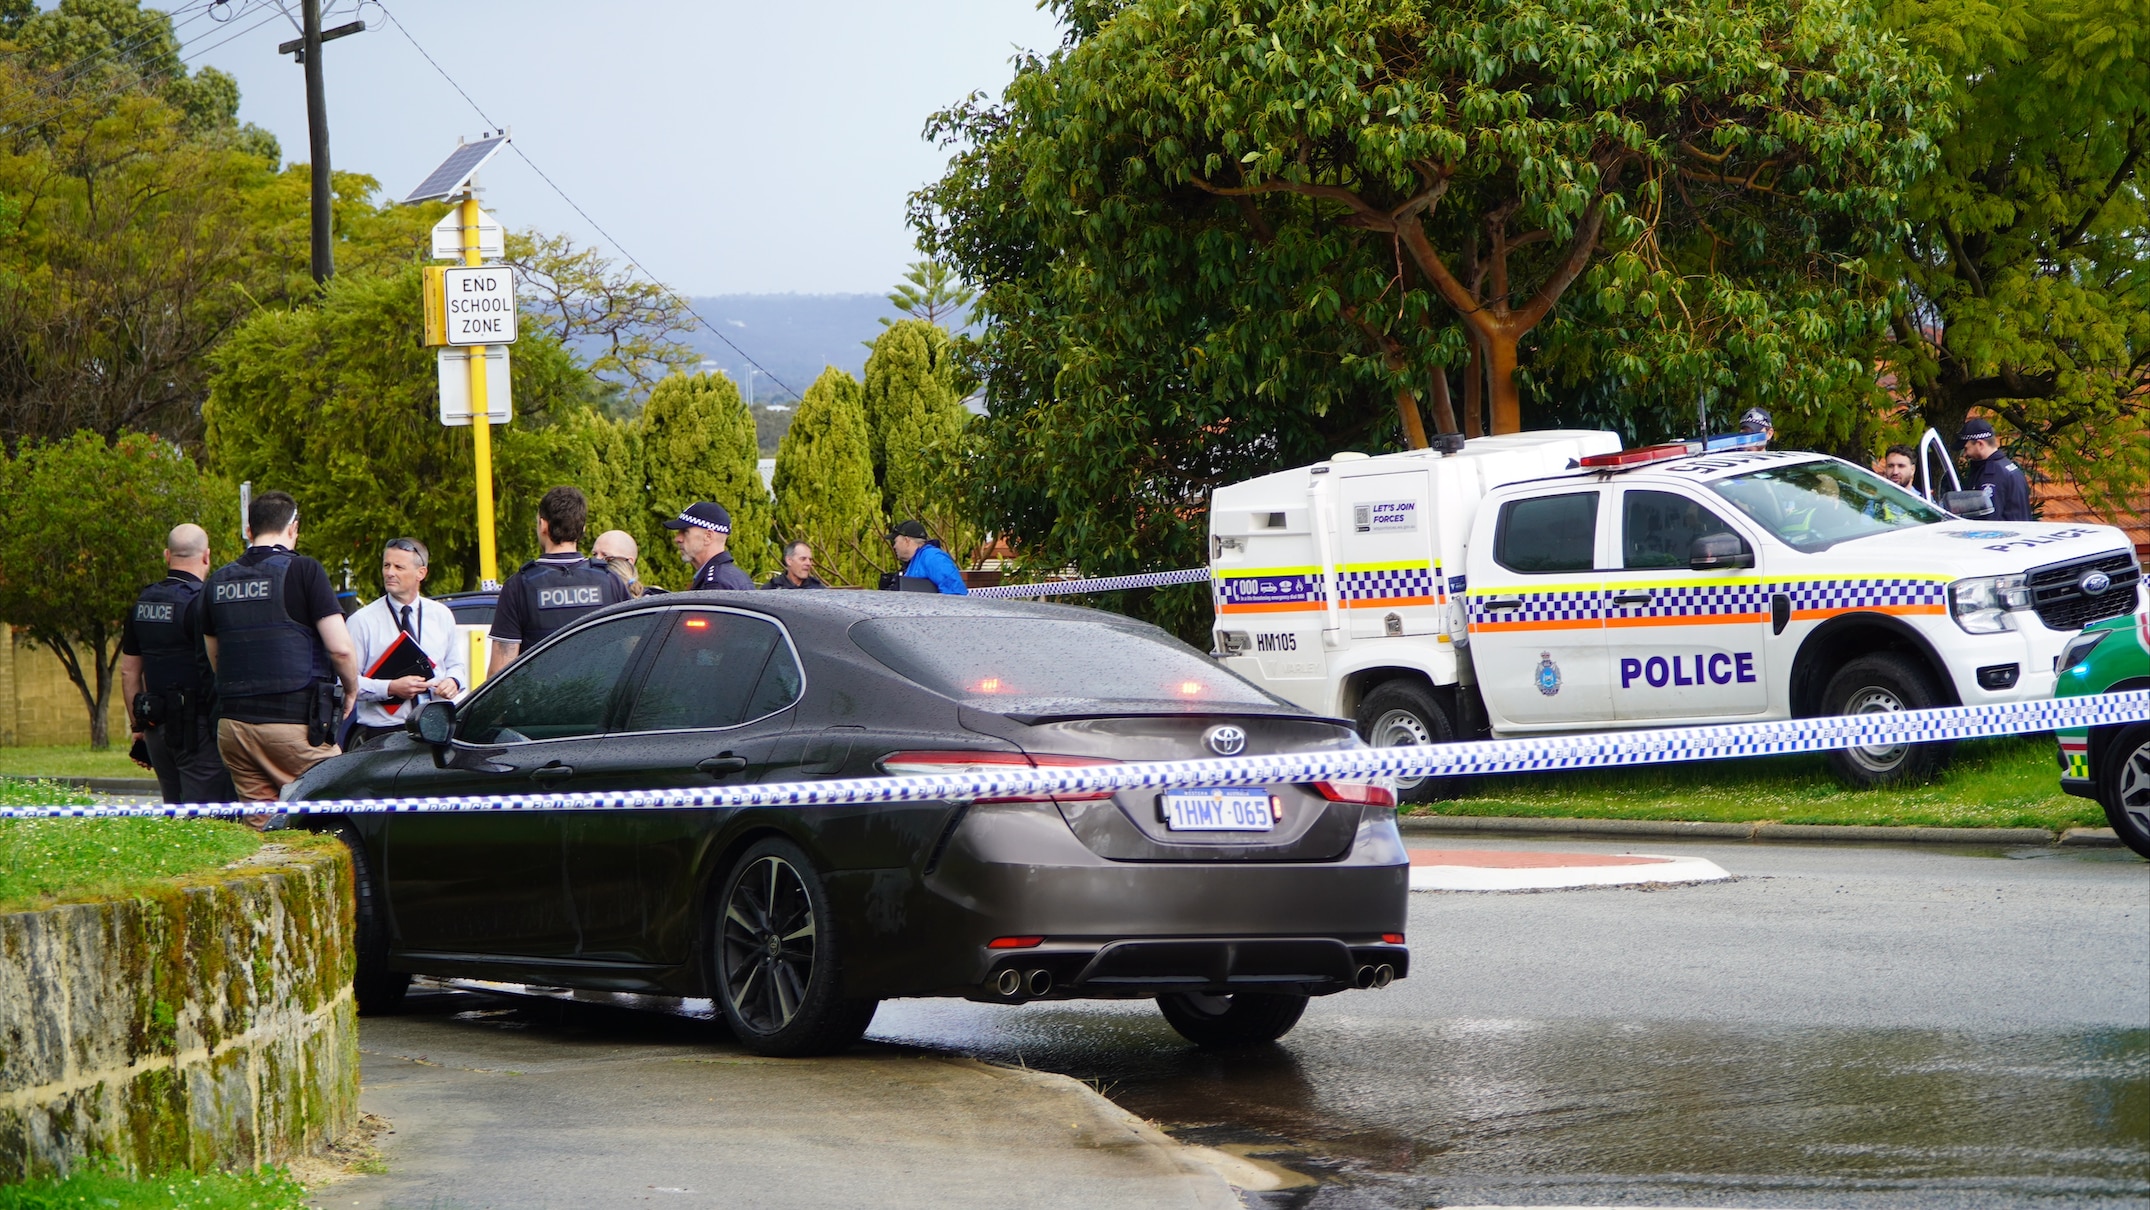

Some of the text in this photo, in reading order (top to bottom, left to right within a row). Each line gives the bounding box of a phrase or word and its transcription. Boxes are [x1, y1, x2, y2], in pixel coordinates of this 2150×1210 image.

[463, 278, 497, 292] END
[451, 298, 511, 313] SCHOOL
[462, 318, 502, 333] ZONE
[1373, 502, 1415, 513] LET'S JOIN
[1373, 514, 1405, 523] FORCES
[1982, 528, 2100, 552] POLICE
[216, 580, 269, 601] POLICE
[1240, 579, 1258, 595] 000
[541, 588, 599, 606] POLICE
[137, 604, 172, 620] POLICE
[1257, 633, 1296, 651] HM105
[1621, 652, 1757, 688] POLICE
